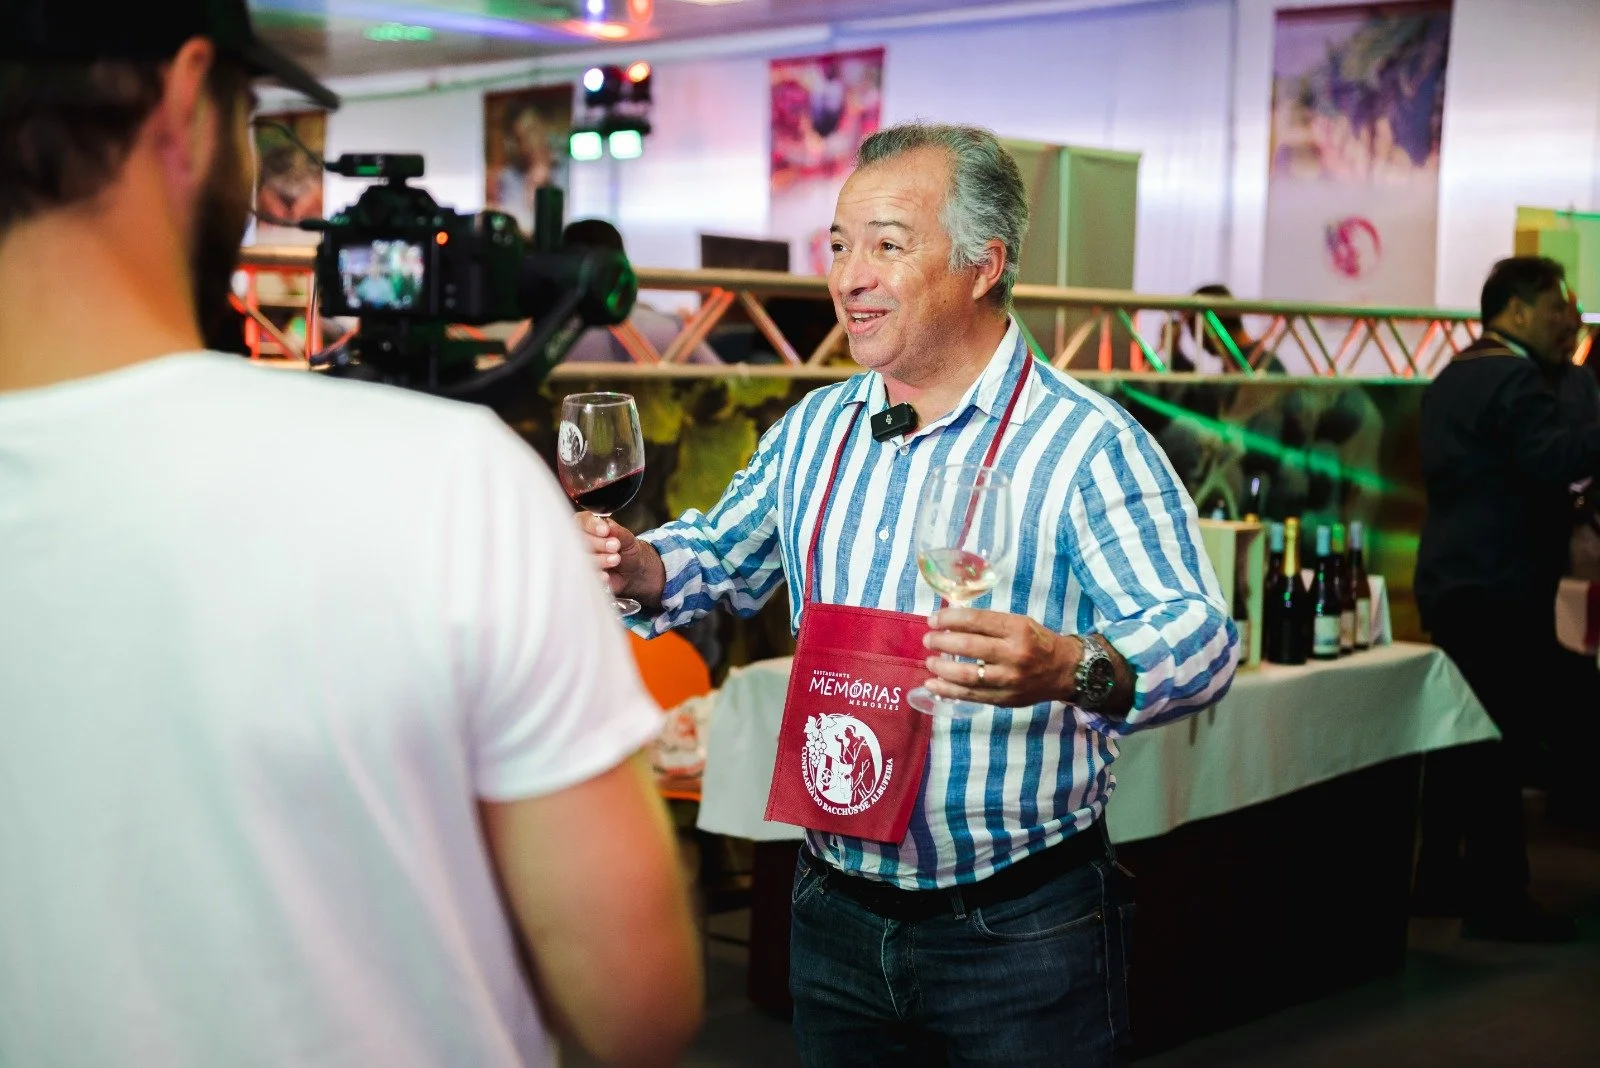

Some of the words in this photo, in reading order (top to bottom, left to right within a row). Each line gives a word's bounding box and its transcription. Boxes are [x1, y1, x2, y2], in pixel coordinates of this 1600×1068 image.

[808, 676, 902, 704] MEMÓRIAS
[801, 746, 815, 798] CONFRARIA
[813, 796, 823, 807] DO
[822, 802, 859, 816] BACCHUS
[859, 801, 871, 812] DE
[871, 757, 894, 805] ALBUFEIRA
